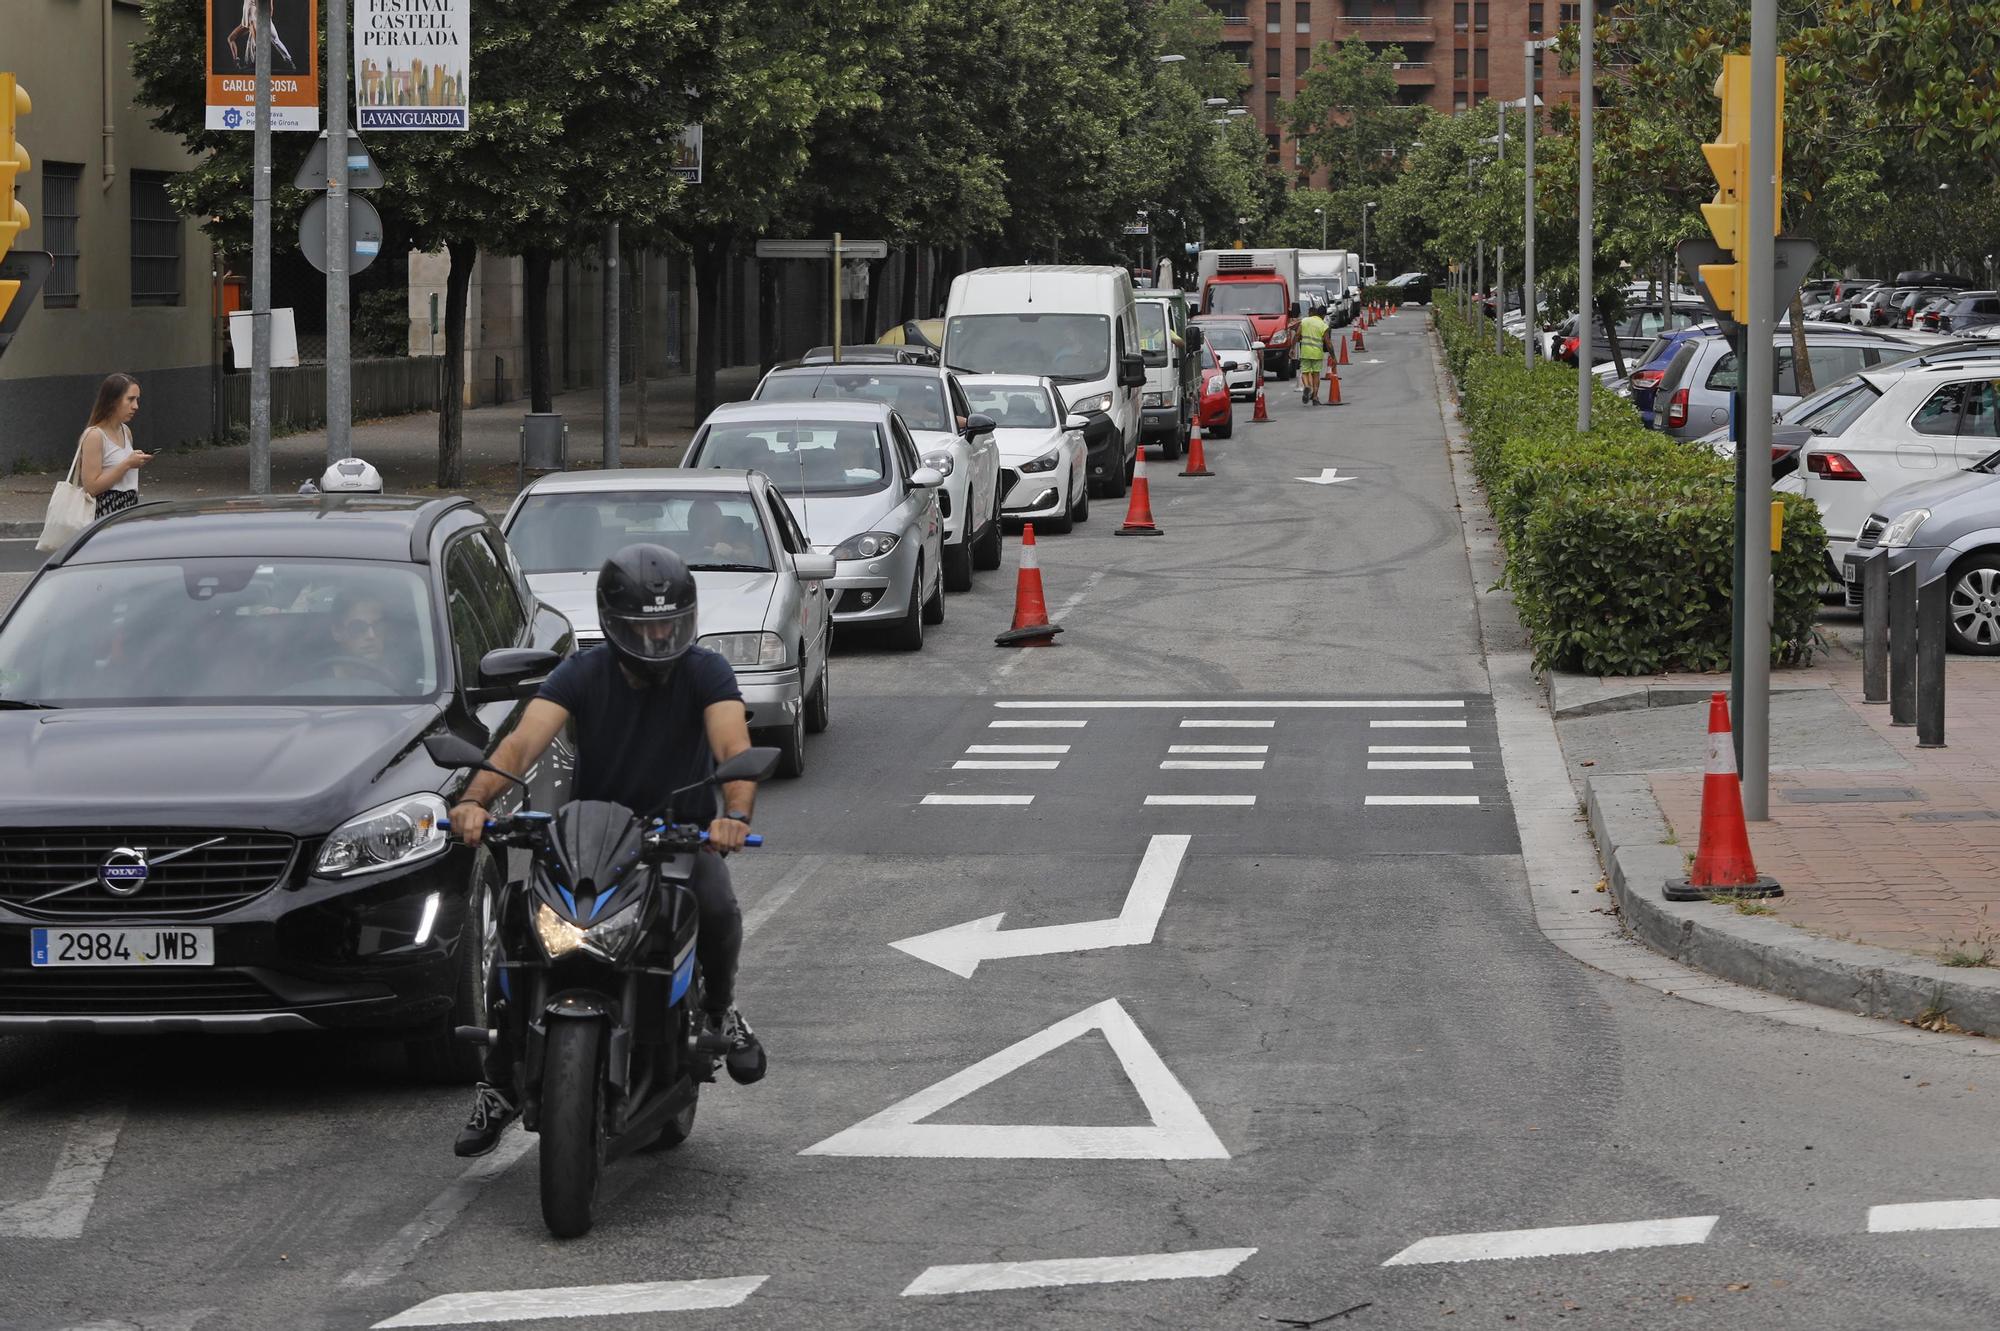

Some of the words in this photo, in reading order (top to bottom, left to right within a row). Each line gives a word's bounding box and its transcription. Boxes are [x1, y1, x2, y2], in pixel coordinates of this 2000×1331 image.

[370, 0, 454, 12] FESTIVAL
[371, 14, 451, 29] CASTELL
[364, 31, 458, 46] PERALADA
[223, 80, 256, 92] CARLO
[270, 80, 298, 92] COSTA
[362, 112, 377, 125] LA
[376, 112, 461, 125] VANGUARDIA
[642, 603, 677, 613] SHARK
[105, 868, 144, 876] VOLVO
[58, 932, 130, 961] 2984
[145, 932, 198, 961] JWB
[37, 950, 44, 959] E
